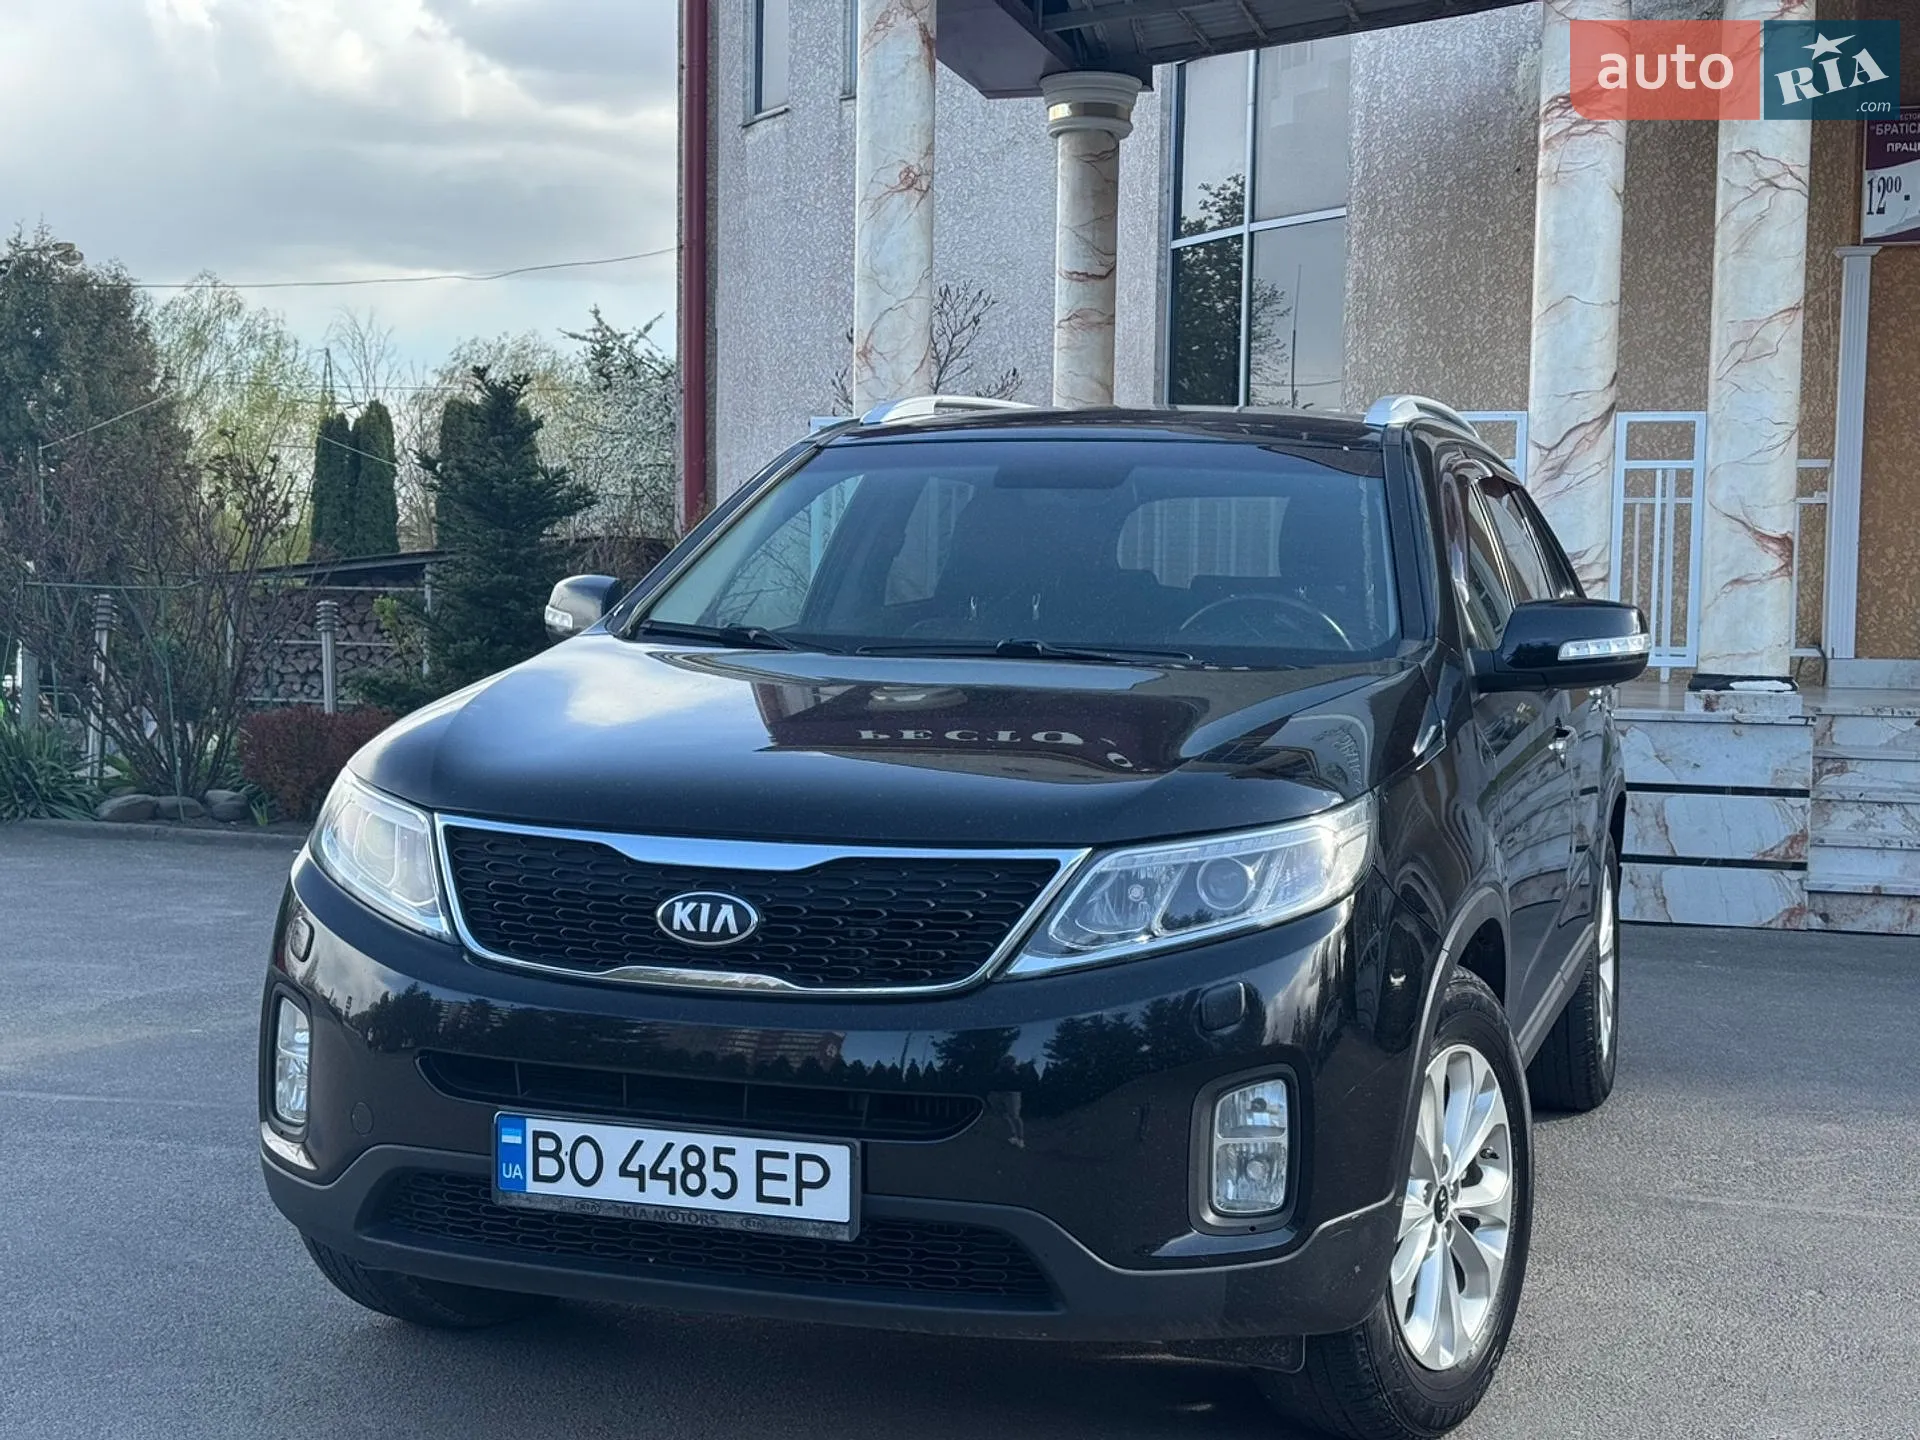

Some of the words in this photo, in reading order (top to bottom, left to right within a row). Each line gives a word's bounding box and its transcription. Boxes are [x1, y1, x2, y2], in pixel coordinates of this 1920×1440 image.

[672, 901, 739, 935] KIA
[502, 1163, 523, 1180] UA
[531, 1129, 604, 1187] BO
[618, 1139, 739, 1200] 4485
[755, 1149, 831, 1207] EP
[653, 1209, 719, 1225] MOTORS
